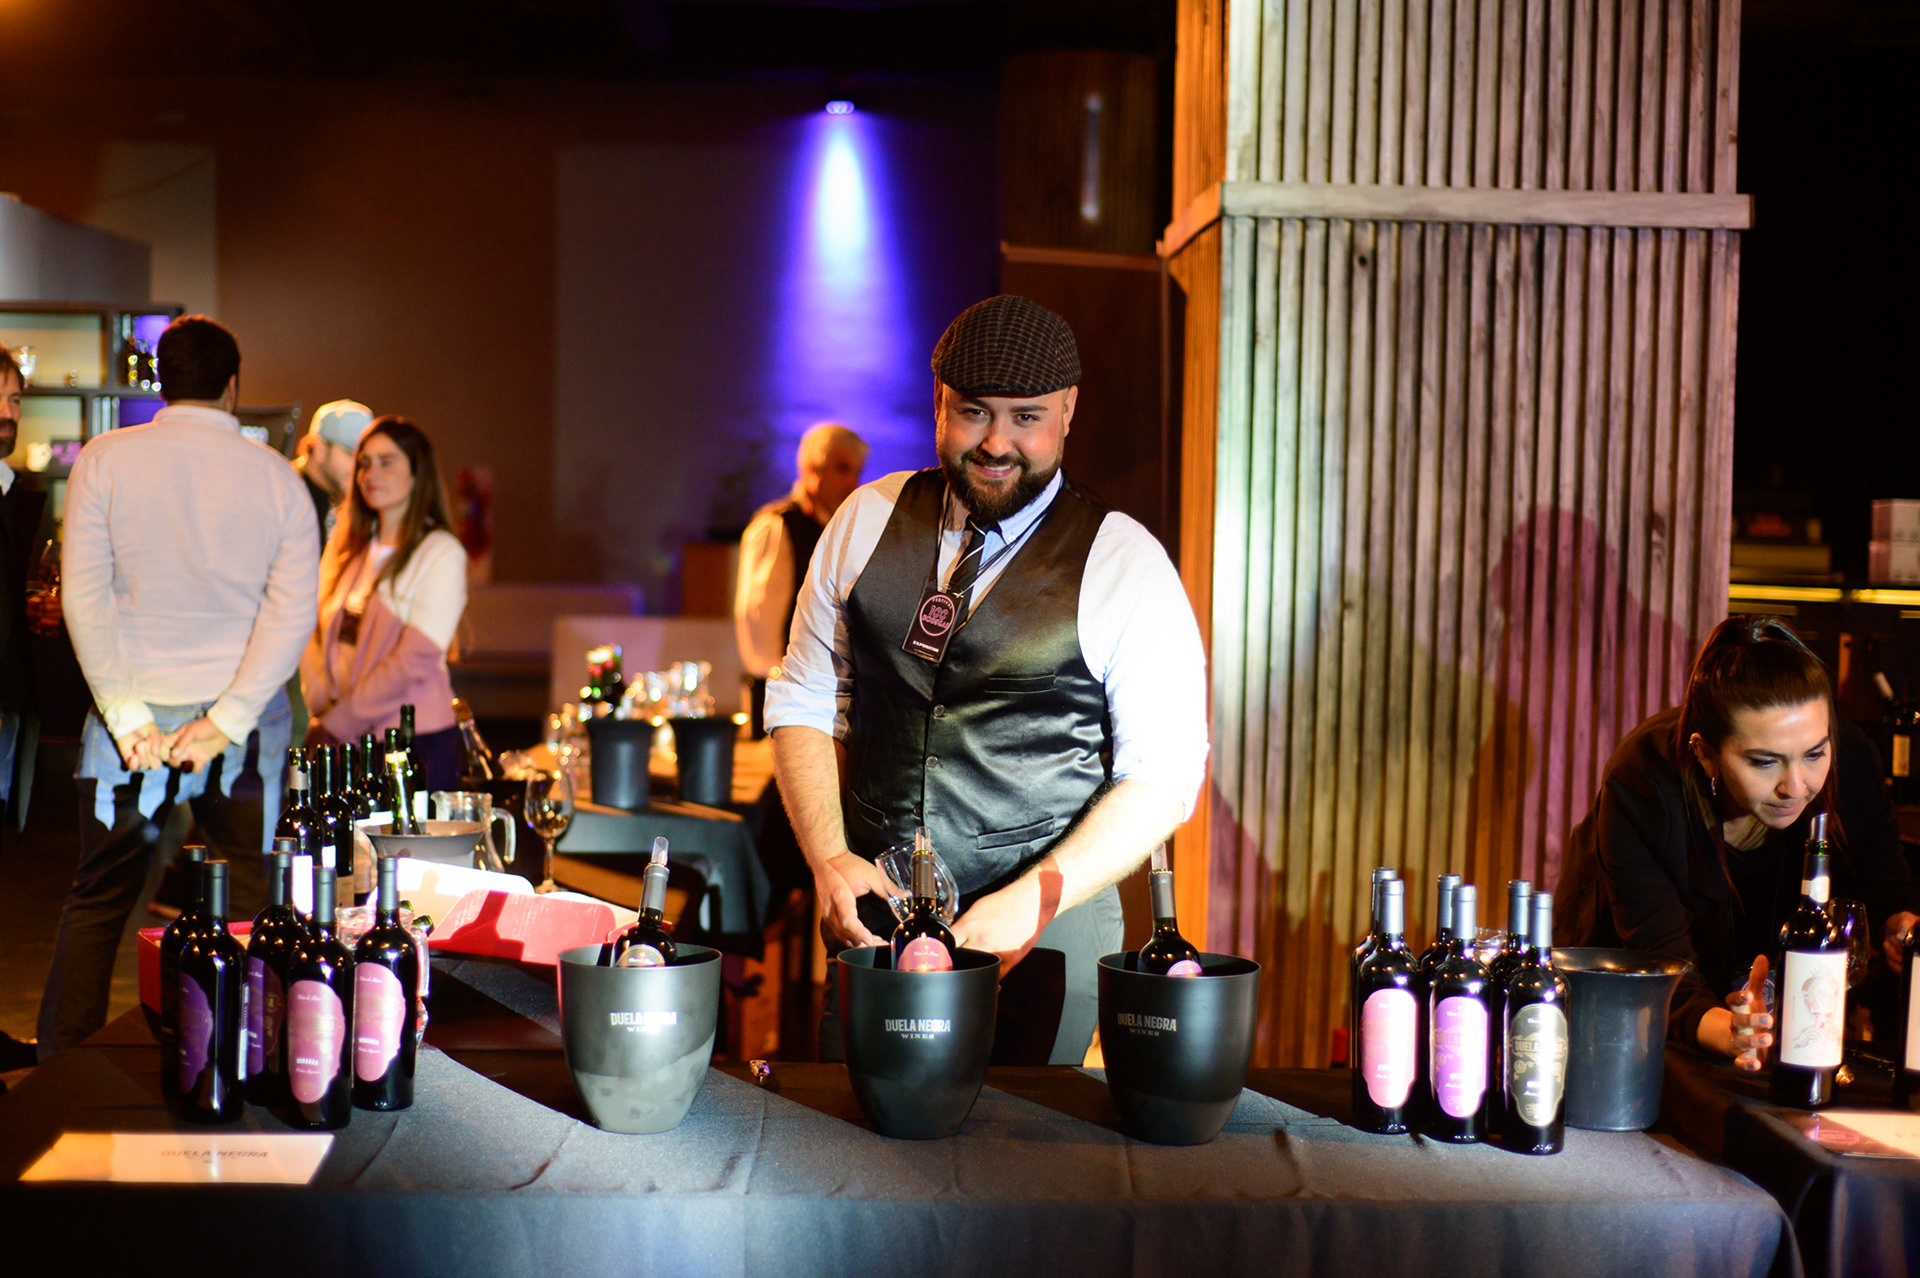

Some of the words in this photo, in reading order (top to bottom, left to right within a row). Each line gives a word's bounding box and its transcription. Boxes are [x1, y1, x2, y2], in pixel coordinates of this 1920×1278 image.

[610, 1012, 642, 1026] DUELA
[885, 1019, 916, 1032] DUELA
[918, 1019, 951, 1032] NEGRA
[1117, 1013, 1143, 1026] DUELA
[1144, 1016, 1177, 1031] NEGRA
[1130, 1028, 1159, 1036] WINES
[161, 1150, 212, 1158] DUELA
[216, 1150, 268, 1158] NEGRA
